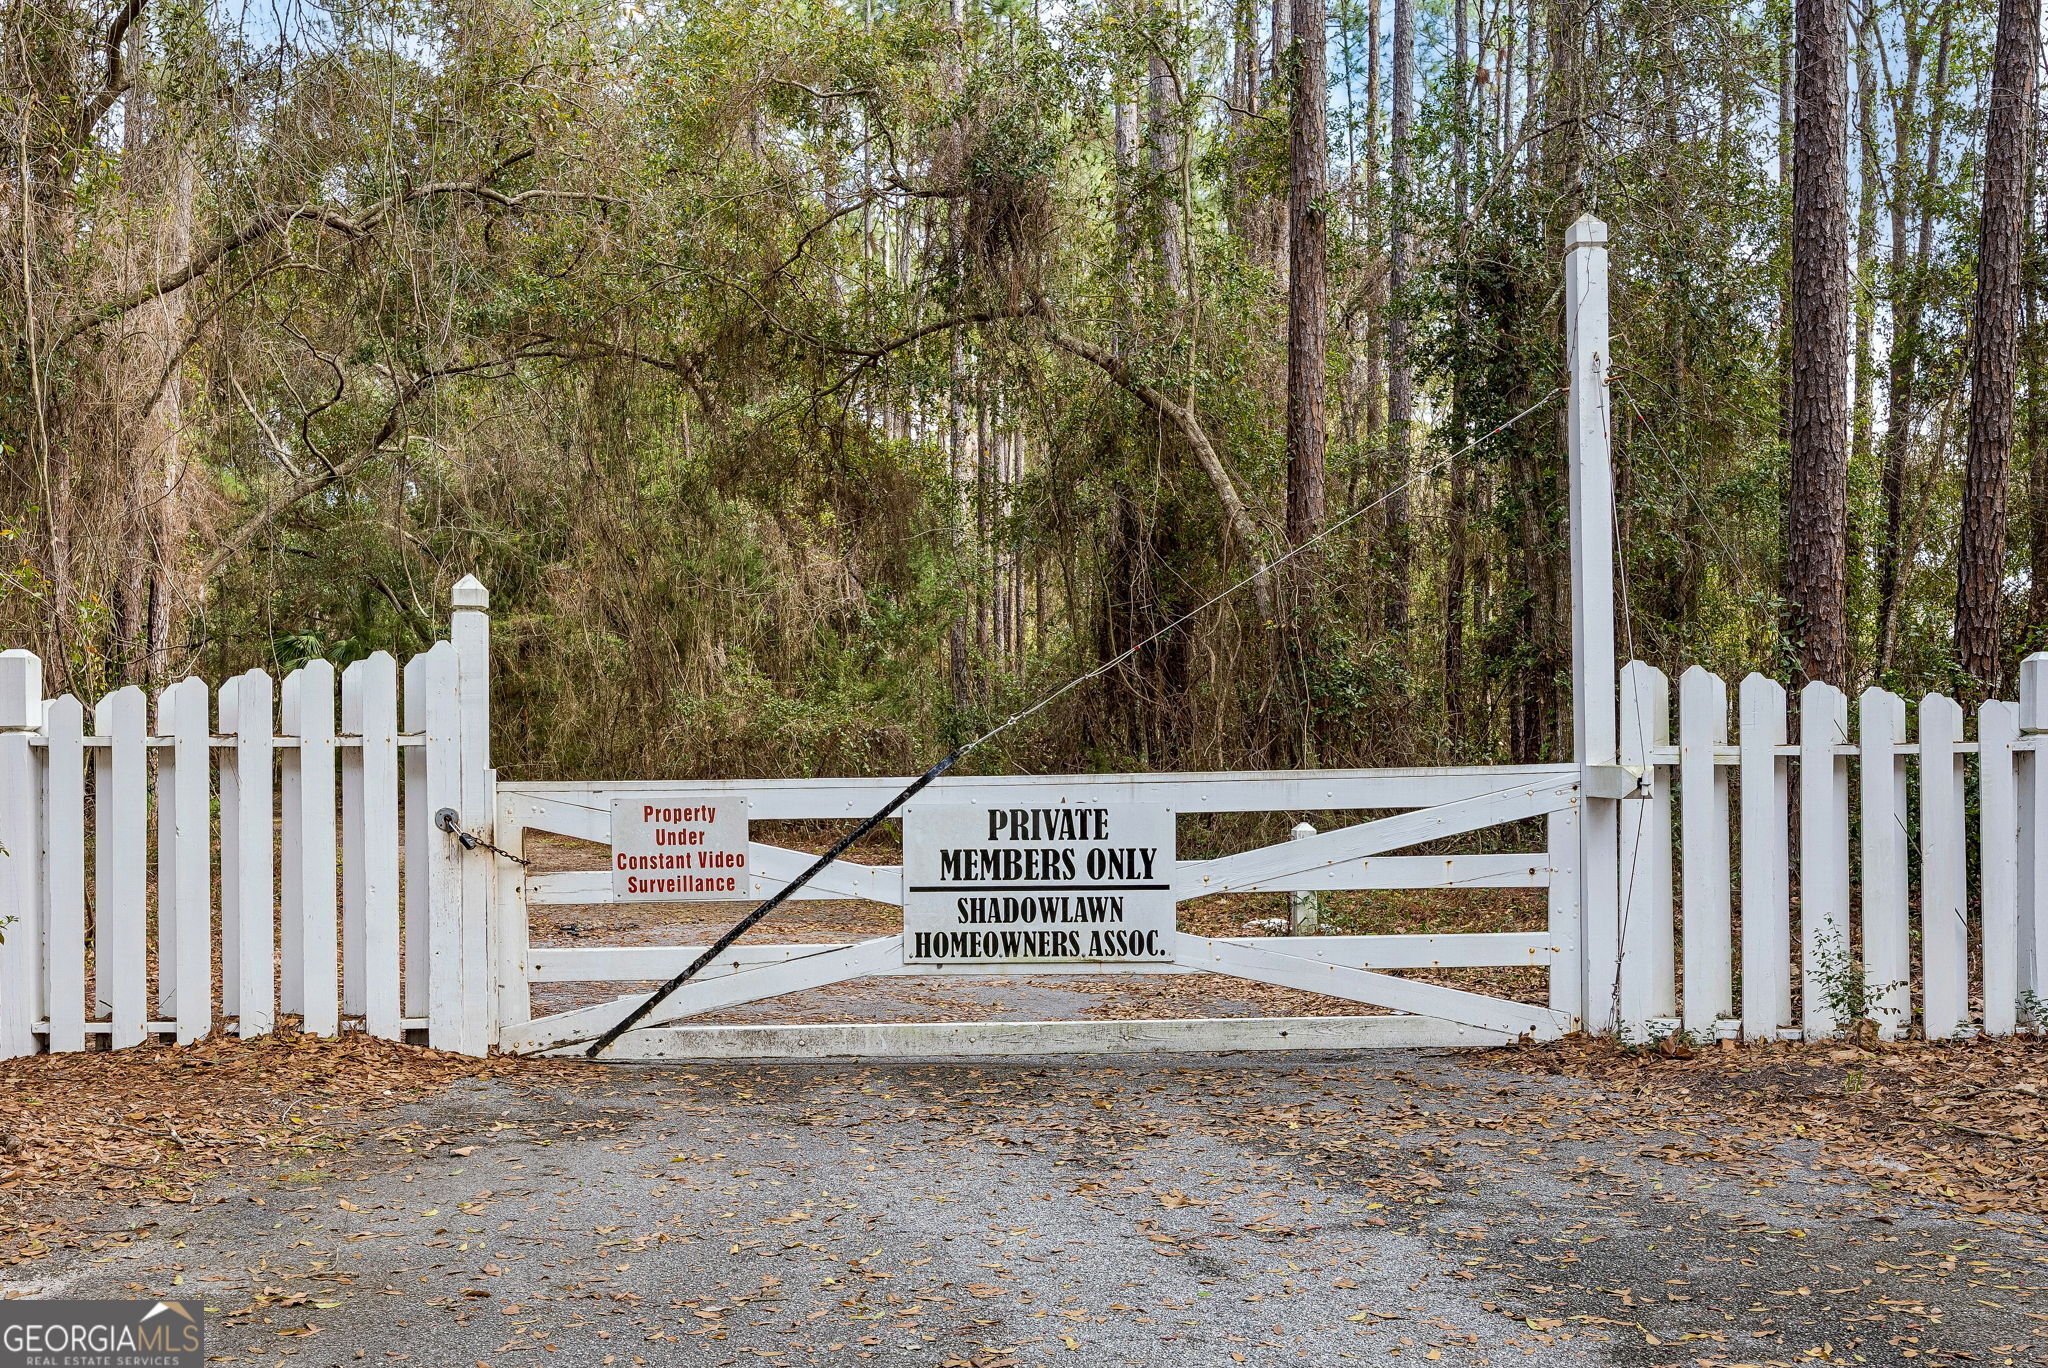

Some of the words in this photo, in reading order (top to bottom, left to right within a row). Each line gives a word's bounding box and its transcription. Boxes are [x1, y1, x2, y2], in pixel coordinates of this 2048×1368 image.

[643, 805, 716, 824] Property
[987, 808, 1109, 841] PRIVATE
[655, 828, 705, 846] Under
[617, 852, 692, 870] Constant
[697, 851, 745, 868] Video
[940, 848, 1076, 881] MEMBERS
[1086, 847, 1157, 880] ONLY
[627, 875, 736, 893] Surveillance
[957, 896, 1124, 924] SHADOWLAWN
[914, 931, 1080, 958] HOMEOWNERS
[1088, 929, 1166, 957] ASSOC.
